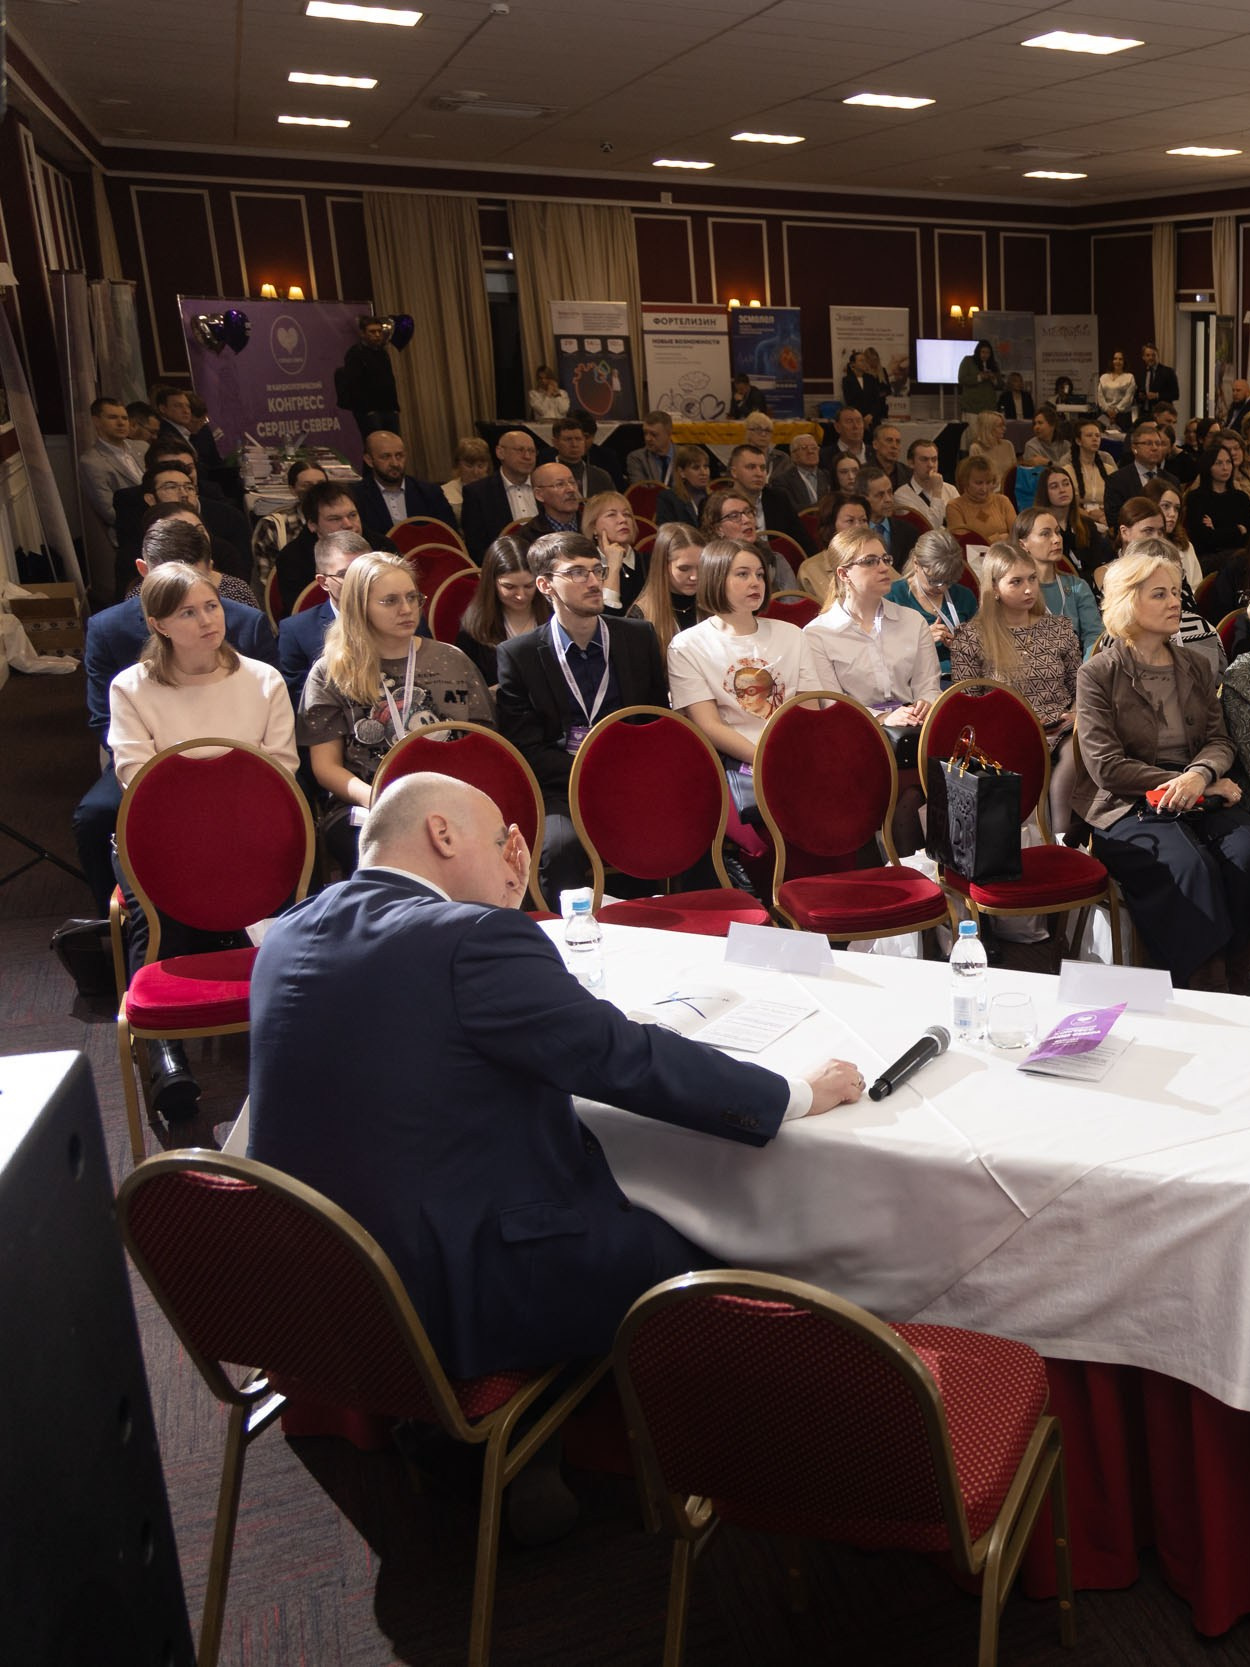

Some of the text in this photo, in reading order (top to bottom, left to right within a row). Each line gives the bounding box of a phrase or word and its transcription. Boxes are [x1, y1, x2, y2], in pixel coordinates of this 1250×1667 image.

[653, 317, 716, 326] ФОРТЕЛИЗИН
[267, 396, 324, 412] КОНГРЕСС
[256, 417, 340, 437] СЕРДЦЕ СЕВЕРА
